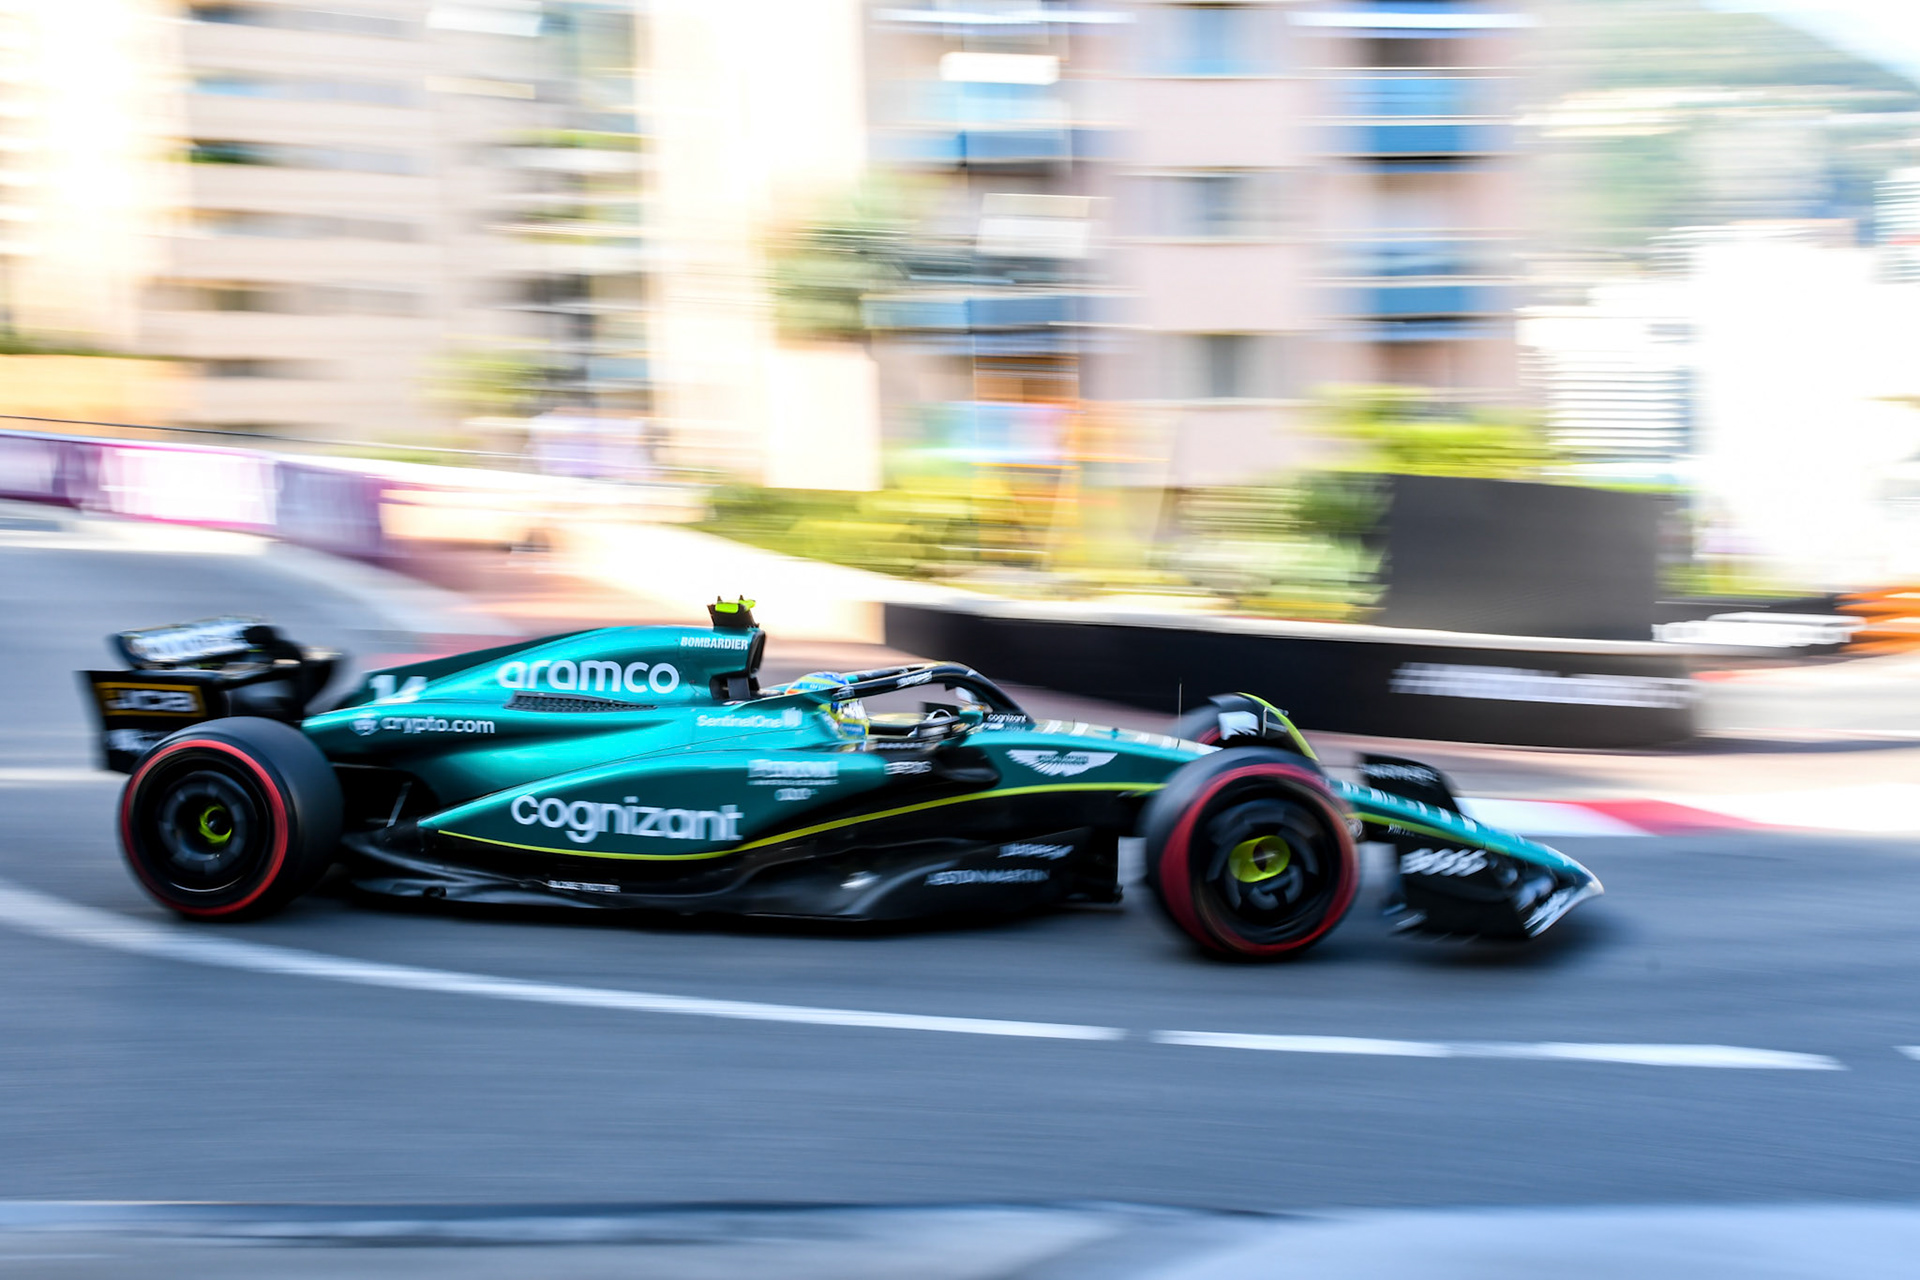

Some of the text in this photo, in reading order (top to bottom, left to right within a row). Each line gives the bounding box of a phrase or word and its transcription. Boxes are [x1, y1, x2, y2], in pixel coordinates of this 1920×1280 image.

[680, 636, 748, 650] BOMBARDIER
[496, 659, 680, 694] aramco
[369, 674, 428, 703] 14
[380, 716, 495, 734] crypto.com
[697, 715, 782, 728] SentinelOne
[987, 712, 1027, 725] cognizant
[510, 795, 744, 844] cognizant
